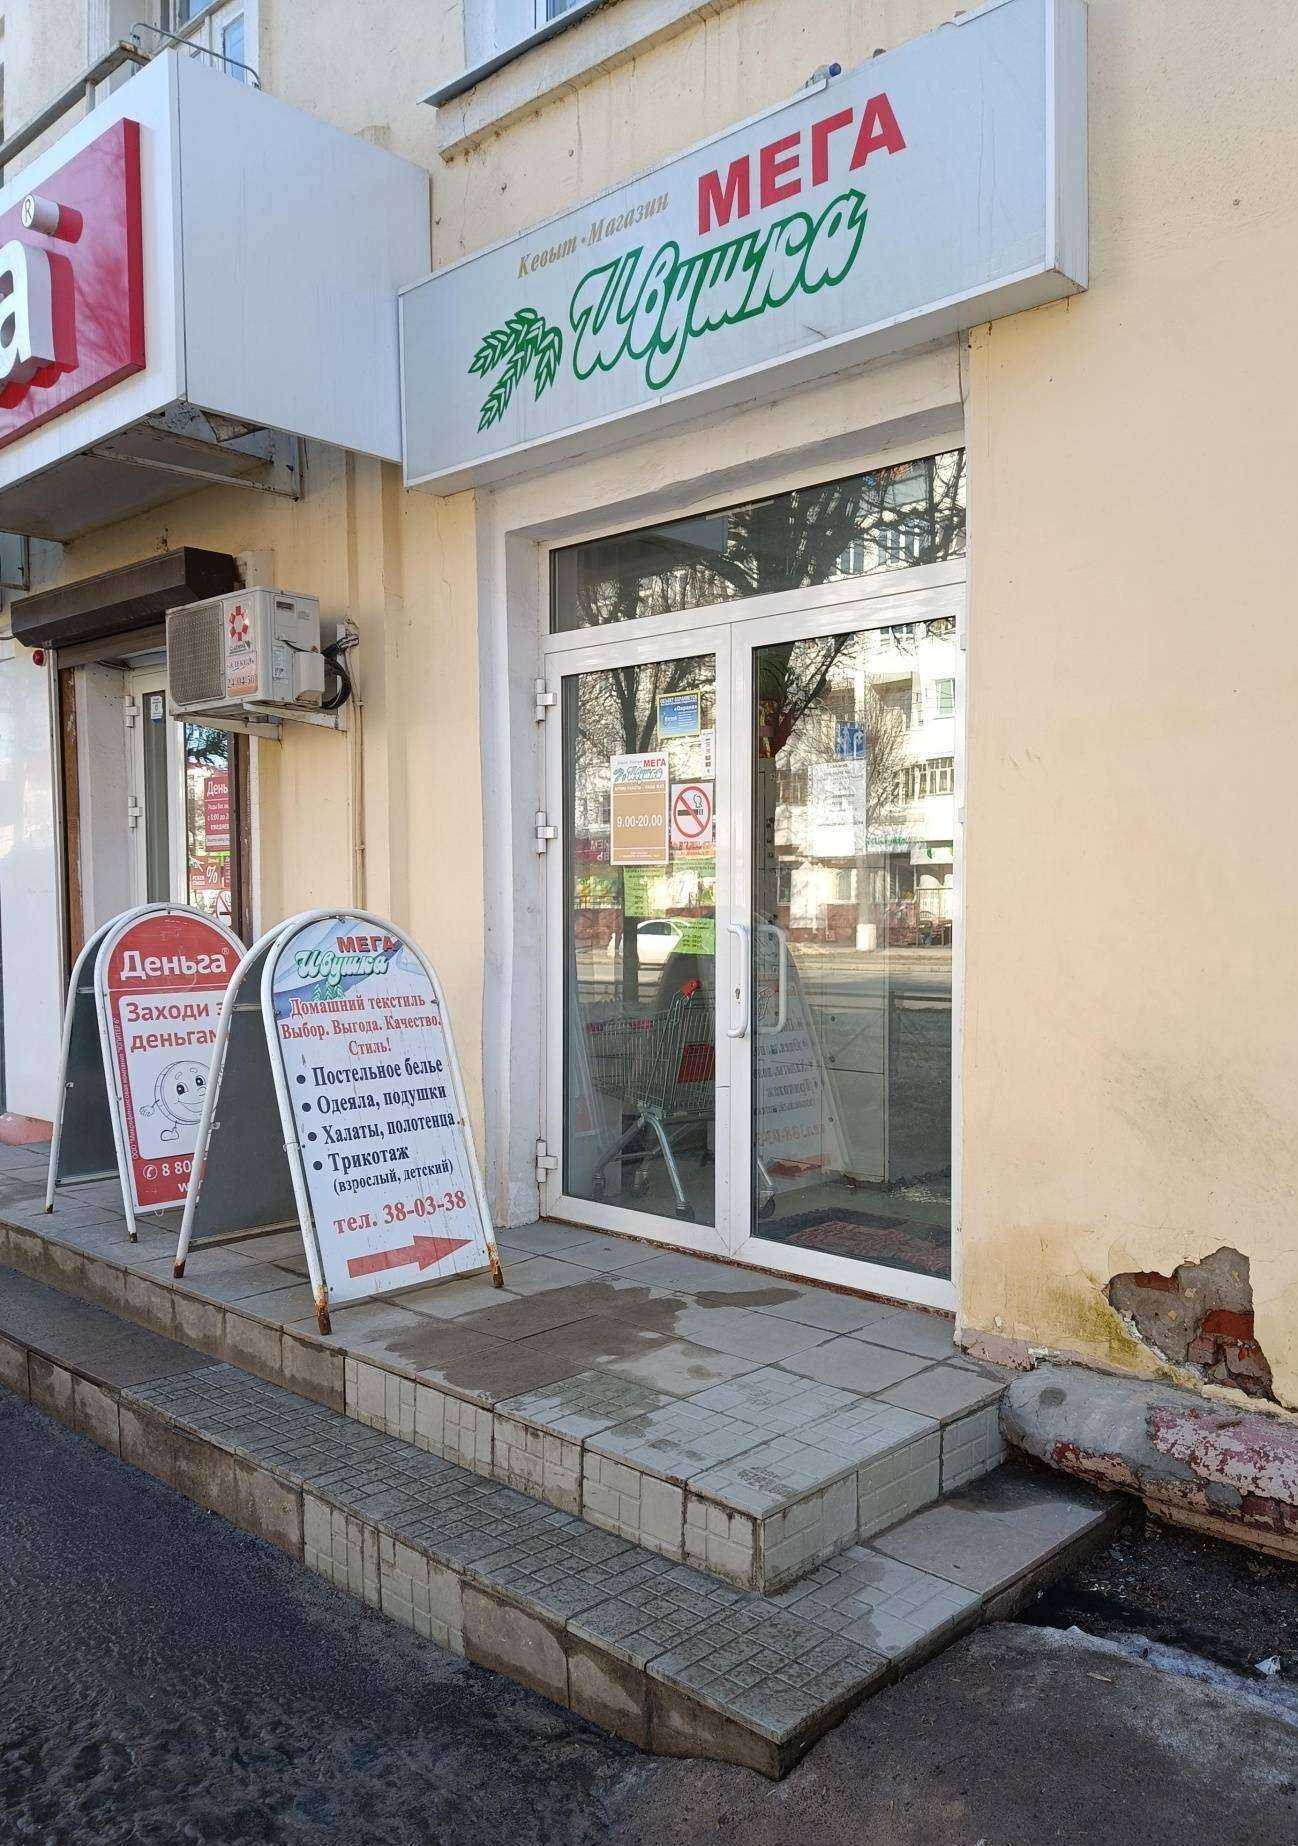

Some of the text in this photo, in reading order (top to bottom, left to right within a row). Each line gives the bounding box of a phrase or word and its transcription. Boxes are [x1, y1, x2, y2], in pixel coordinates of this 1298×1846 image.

[698, 92, 907, 235] МЕГА
[643, 758, 667, 768] МЕГА
[207, 781, 229, 798] День
[616, 814, 663, 828] 9.00-20.00
[337, 935, 396, 954] МЕГА
[294, 949, 390, 987] Ивушка
[126, 1001, 210, 1023] Заходи
[290, 994, 426, 1020] Домашний текстиль
[281, 1013, 442, 1041] Выбор. Выгода. Качество.
[130, 1029, 217, 1053] деньгам
[348, 1036, 392, 1056] Стиль!
[311, 1057, 443, 1087] Постельное белье
[317, 1085, 447, 1115] Одеяла, подушки
[322, 1123, 385, 1145] Халаты,
[173, 1160, 192, 1175] 80
[327, 1145, 410, 1176] Трикотаж
[332, 1158, 454, 1196] (взрослый, детский)
[333, 1189, 468, 1236] тел. 38-03-38
